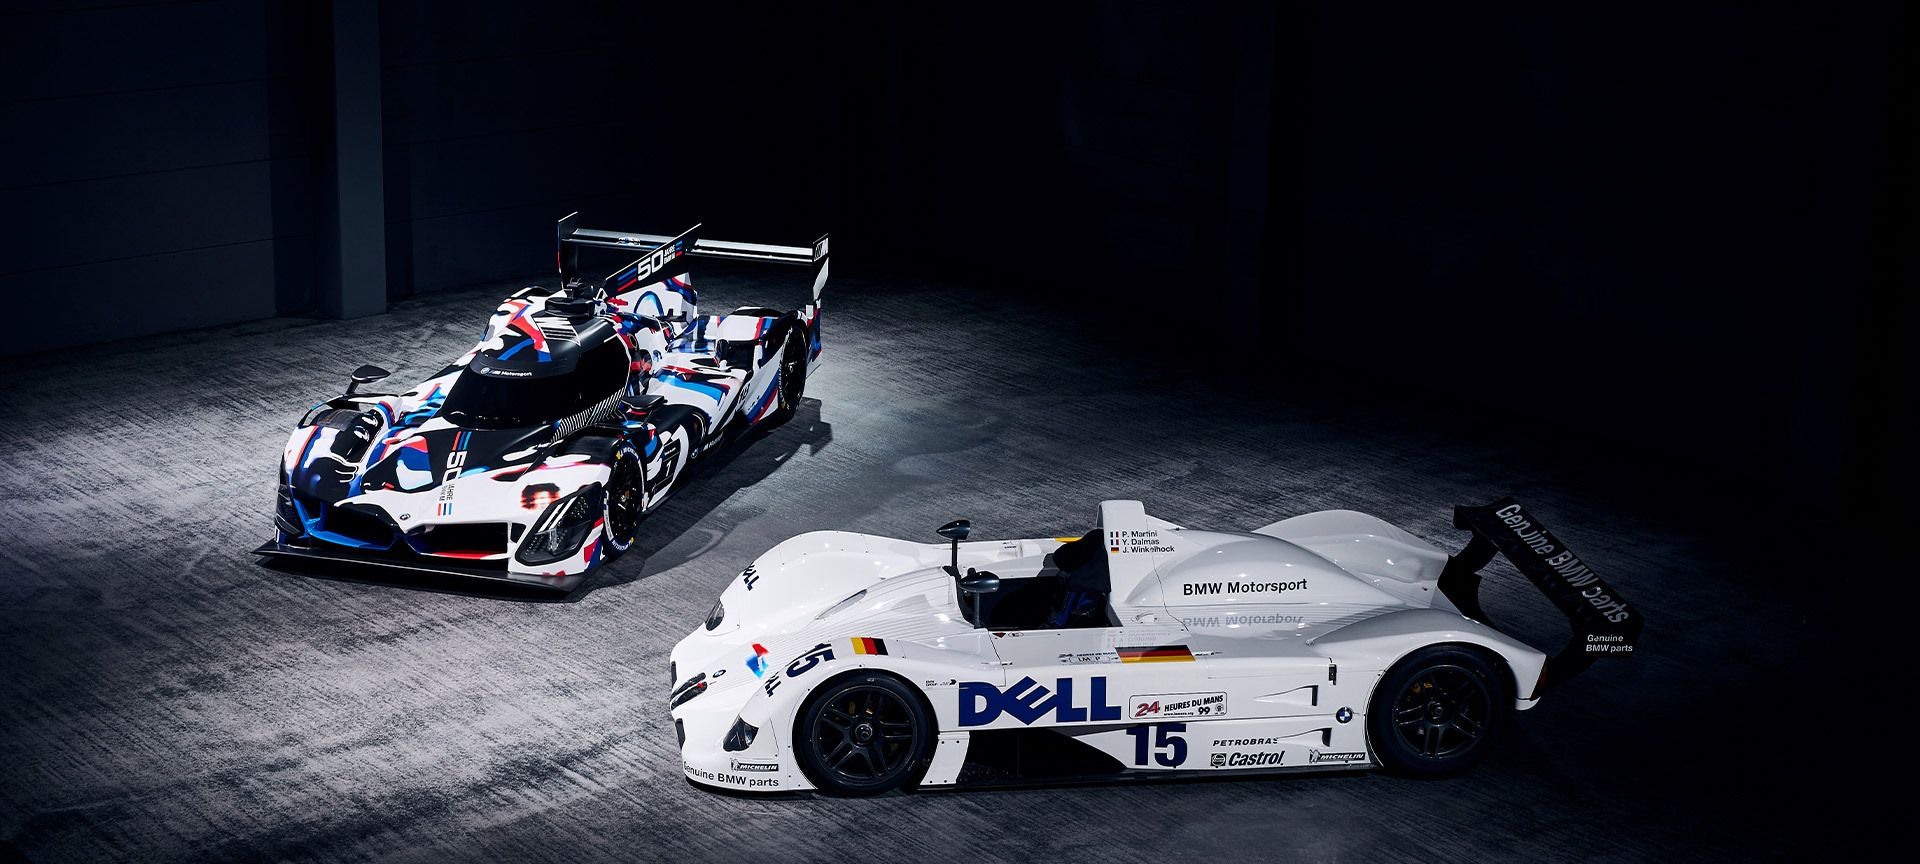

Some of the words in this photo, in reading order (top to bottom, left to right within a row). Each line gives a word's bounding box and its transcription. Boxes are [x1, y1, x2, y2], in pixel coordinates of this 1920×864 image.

[637, 249, 664, 281] 50
[441, 450, 468, 485] 50
[1131, 530, 1158, 538] Martini
[1131, 538, 1160, 546] Dalmas
[1131, 545, 1175, 553] Winkelhock
[1495, 503, 1555, 555] Genuine
[1545, 550, 1600, 587] BMW
[1183, 582, 1222, 596] BMW
[1227, 578, 1308, 594] Motorsport
[1587, 634, 1624, 642] Genuine
[1586, 644, 1610, 652] BMW
[1610, 644, 1633, 653] parts
[785, 643, 837, 678] 15
[959, 676, 1121, 727] DELL
[1135, 701, 1160, 717] 24
[1164, 700, 1190, 712] HEURES
[1191, 699, 1202, 708] DU
[1203, 695, 1224, 705] MANS
[1198, 706, 1211, 715] 99
[1126, 721, 1187, 769] 15
[1213, 738, 1278, 747] PETROBRAS
[1229, 750, 1286, 767] Castrol
[740, 763, 778, 771] MICHELIN
[717, 773, 747, 786] BMW
[749, 777, 779, 788] parts
